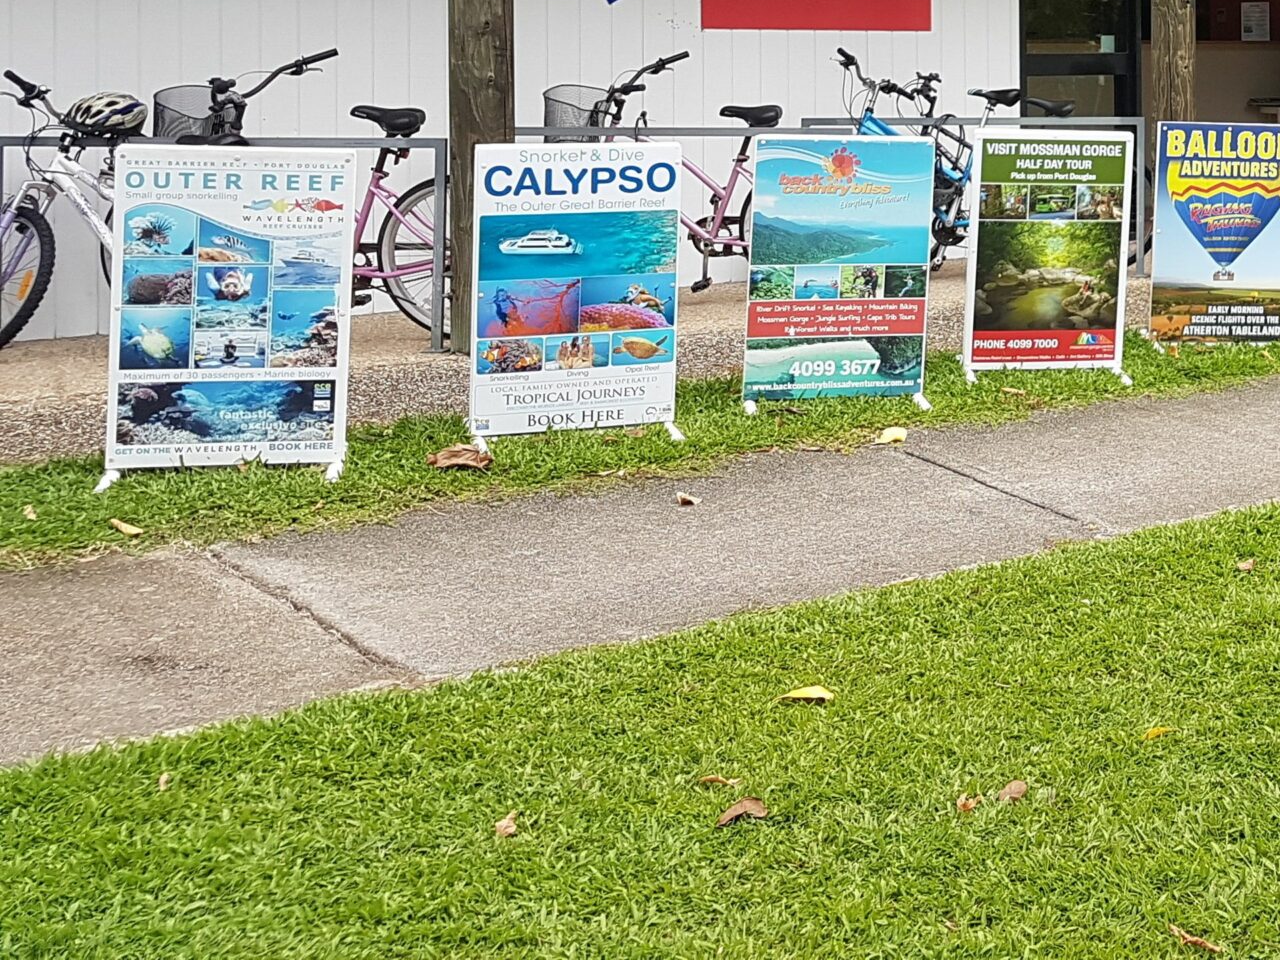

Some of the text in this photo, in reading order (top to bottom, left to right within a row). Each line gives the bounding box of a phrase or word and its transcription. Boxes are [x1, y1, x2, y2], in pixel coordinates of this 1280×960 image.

[520, 148, 645, 163] Snorkel & Dive
[987, 143, 1122, 157] VISIT MOSSMAN GORGE
[1016, 160, 1092, 169] HALF DAY TOUR
[1181, 160, 1278, 177] ADVENTURES
[125, 171, 344, 191] OUTER REEF
[484, 162, 676, 196] CALYPSO
[779, 174, 824, 185] back
[1070, 173, 1096, 181] Douglas
[783, 183, 891, 196] country bliss
[125, 192, 238, 201] Small group snorkelling
[495, 198, 666, 212] The Outer Great Barrier Reef
[1189, 202, 1252, 224] RAGING
[835, 304, 862, 313] Kayaking
[869, 303, 898, 311] Mountain
[900, 303, 918, 312] Biking
[789, 315, 809, 324] Gorge
[816, 314, 836, 323] Jungle
[838, 314, 860, 323] Surfing
[867, 314, 883, 322] Cape
[1183, 326, 1230, 335] ATHERTON
[974, 339, 1058, 349] PHONE 4099 7000
[789, 359, 881, 377] 4099 3677
[124, 370, 331, 380] Maximum of 30 passengers Marine biology
[522, 383, 553, 391] FAMILY
[615, 376, 658, 384] OPERATED
[753, 379, 914, 391] www.backcountryblissadventures.com.au
[503, 392, 574, 406] TROPICAL
[577, 386, 646, 404] JOURNEYS
[219, 410, 274, 419] fantastic
[528, 409, 624, 427] BOOK HERE
[269, 443, 301, 451] BOOK
[304, 442, 333, 450] HERE
